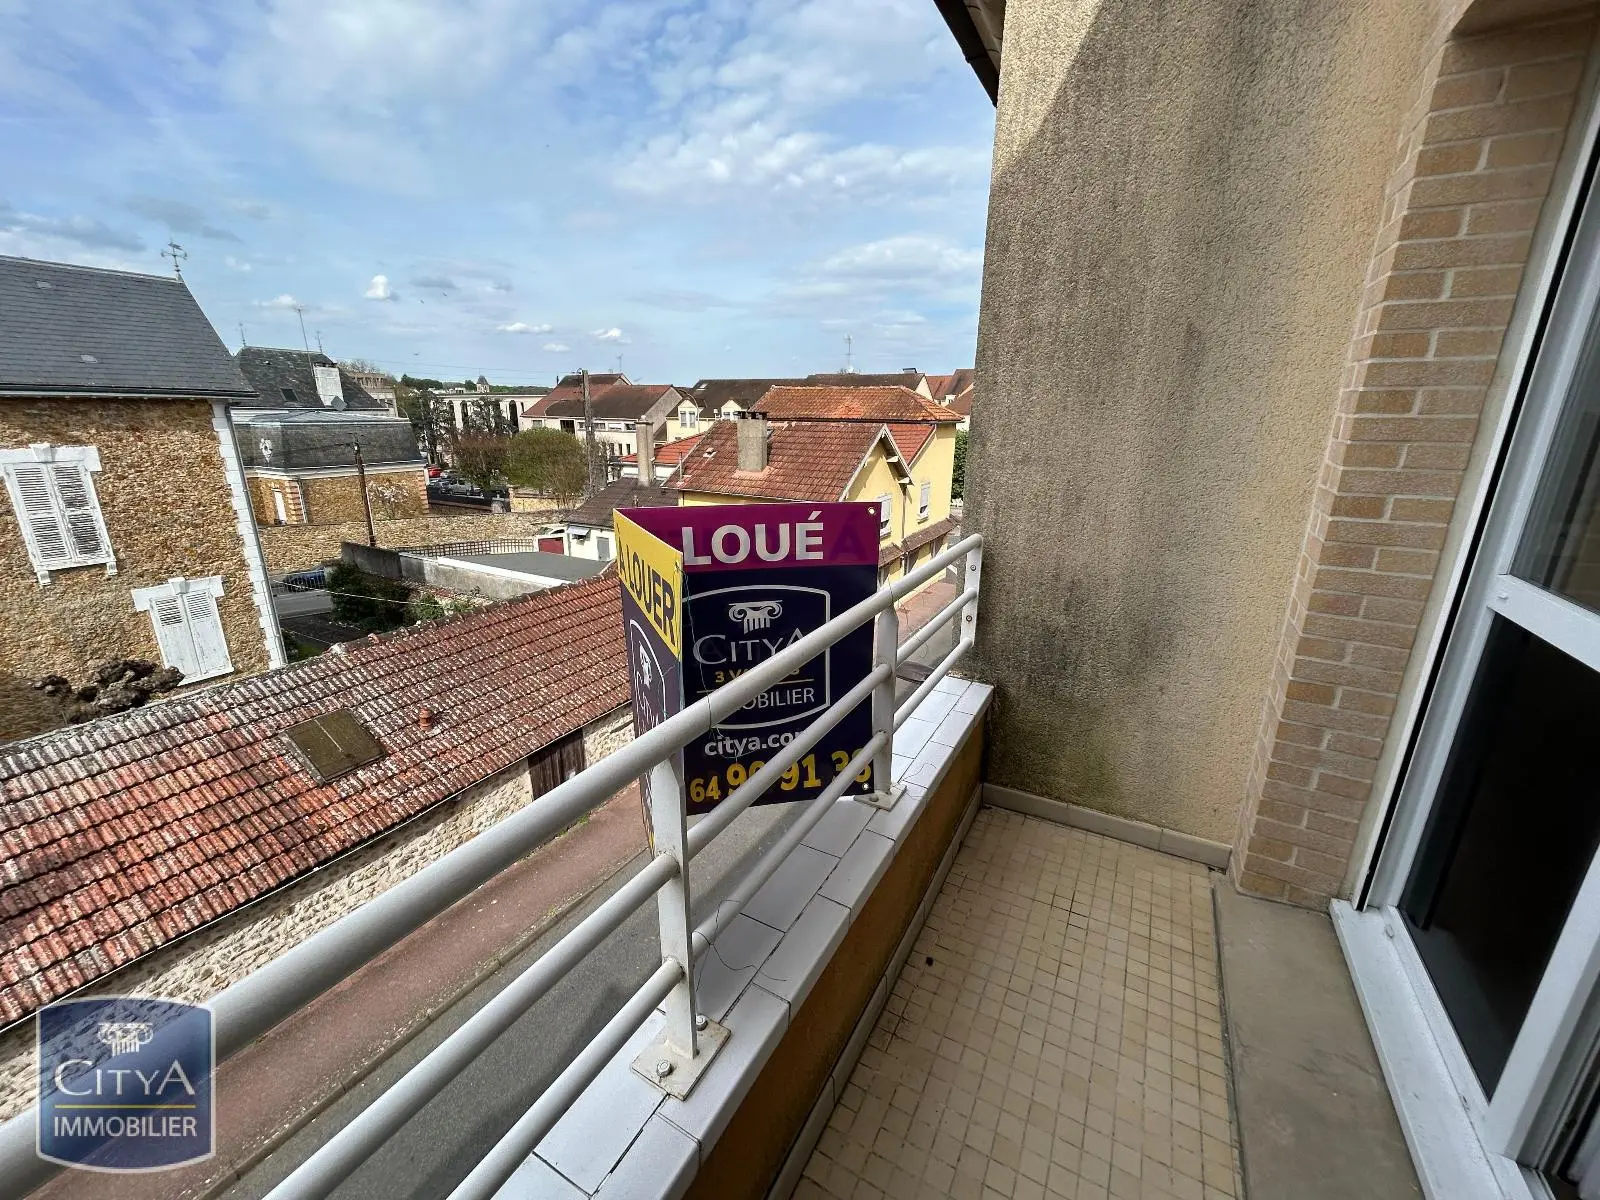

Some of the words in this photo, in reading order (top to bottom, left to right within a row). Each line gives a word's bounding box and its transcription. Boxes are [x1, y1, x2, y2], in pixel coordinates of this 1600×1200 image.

[681, 510, 824, 566] LOUÉ
[626, 543, 676, 647] LOUER
[714, 671, 725, 683] 3
[742, 687, 815, 710] BILIER
[704, 730, 806, 756] citya.co
[689, 775, 721, 803] 64
[780, 753, 822, 791] 91
